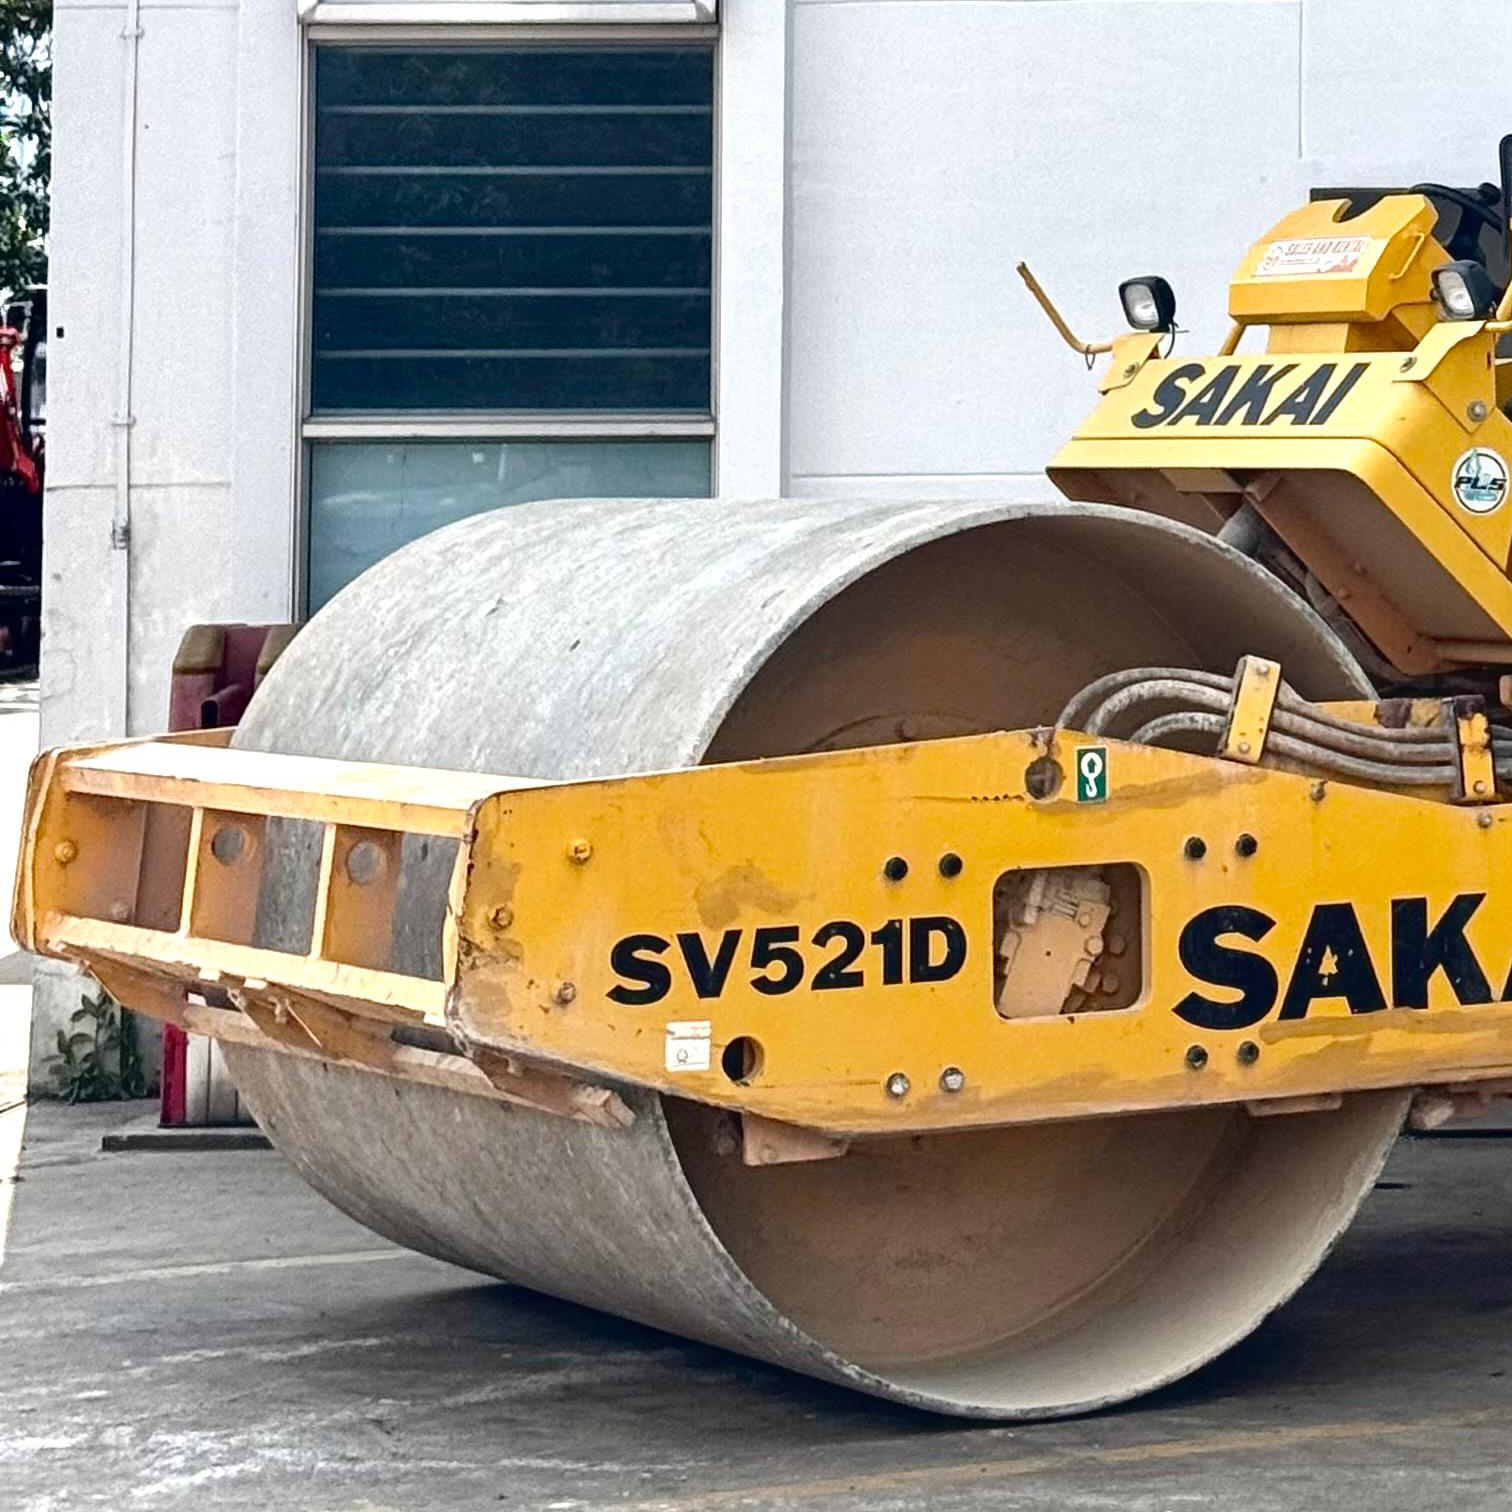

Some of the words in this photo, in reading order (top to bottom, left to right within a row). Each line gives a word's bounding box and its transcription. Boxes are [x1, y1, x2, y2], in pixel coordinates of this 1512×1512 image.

[1131, 363, 1372, 429] SAKAI
[1454, 476, 1508, 491] PLS
[606, 914, 969, 1007] SV521D
